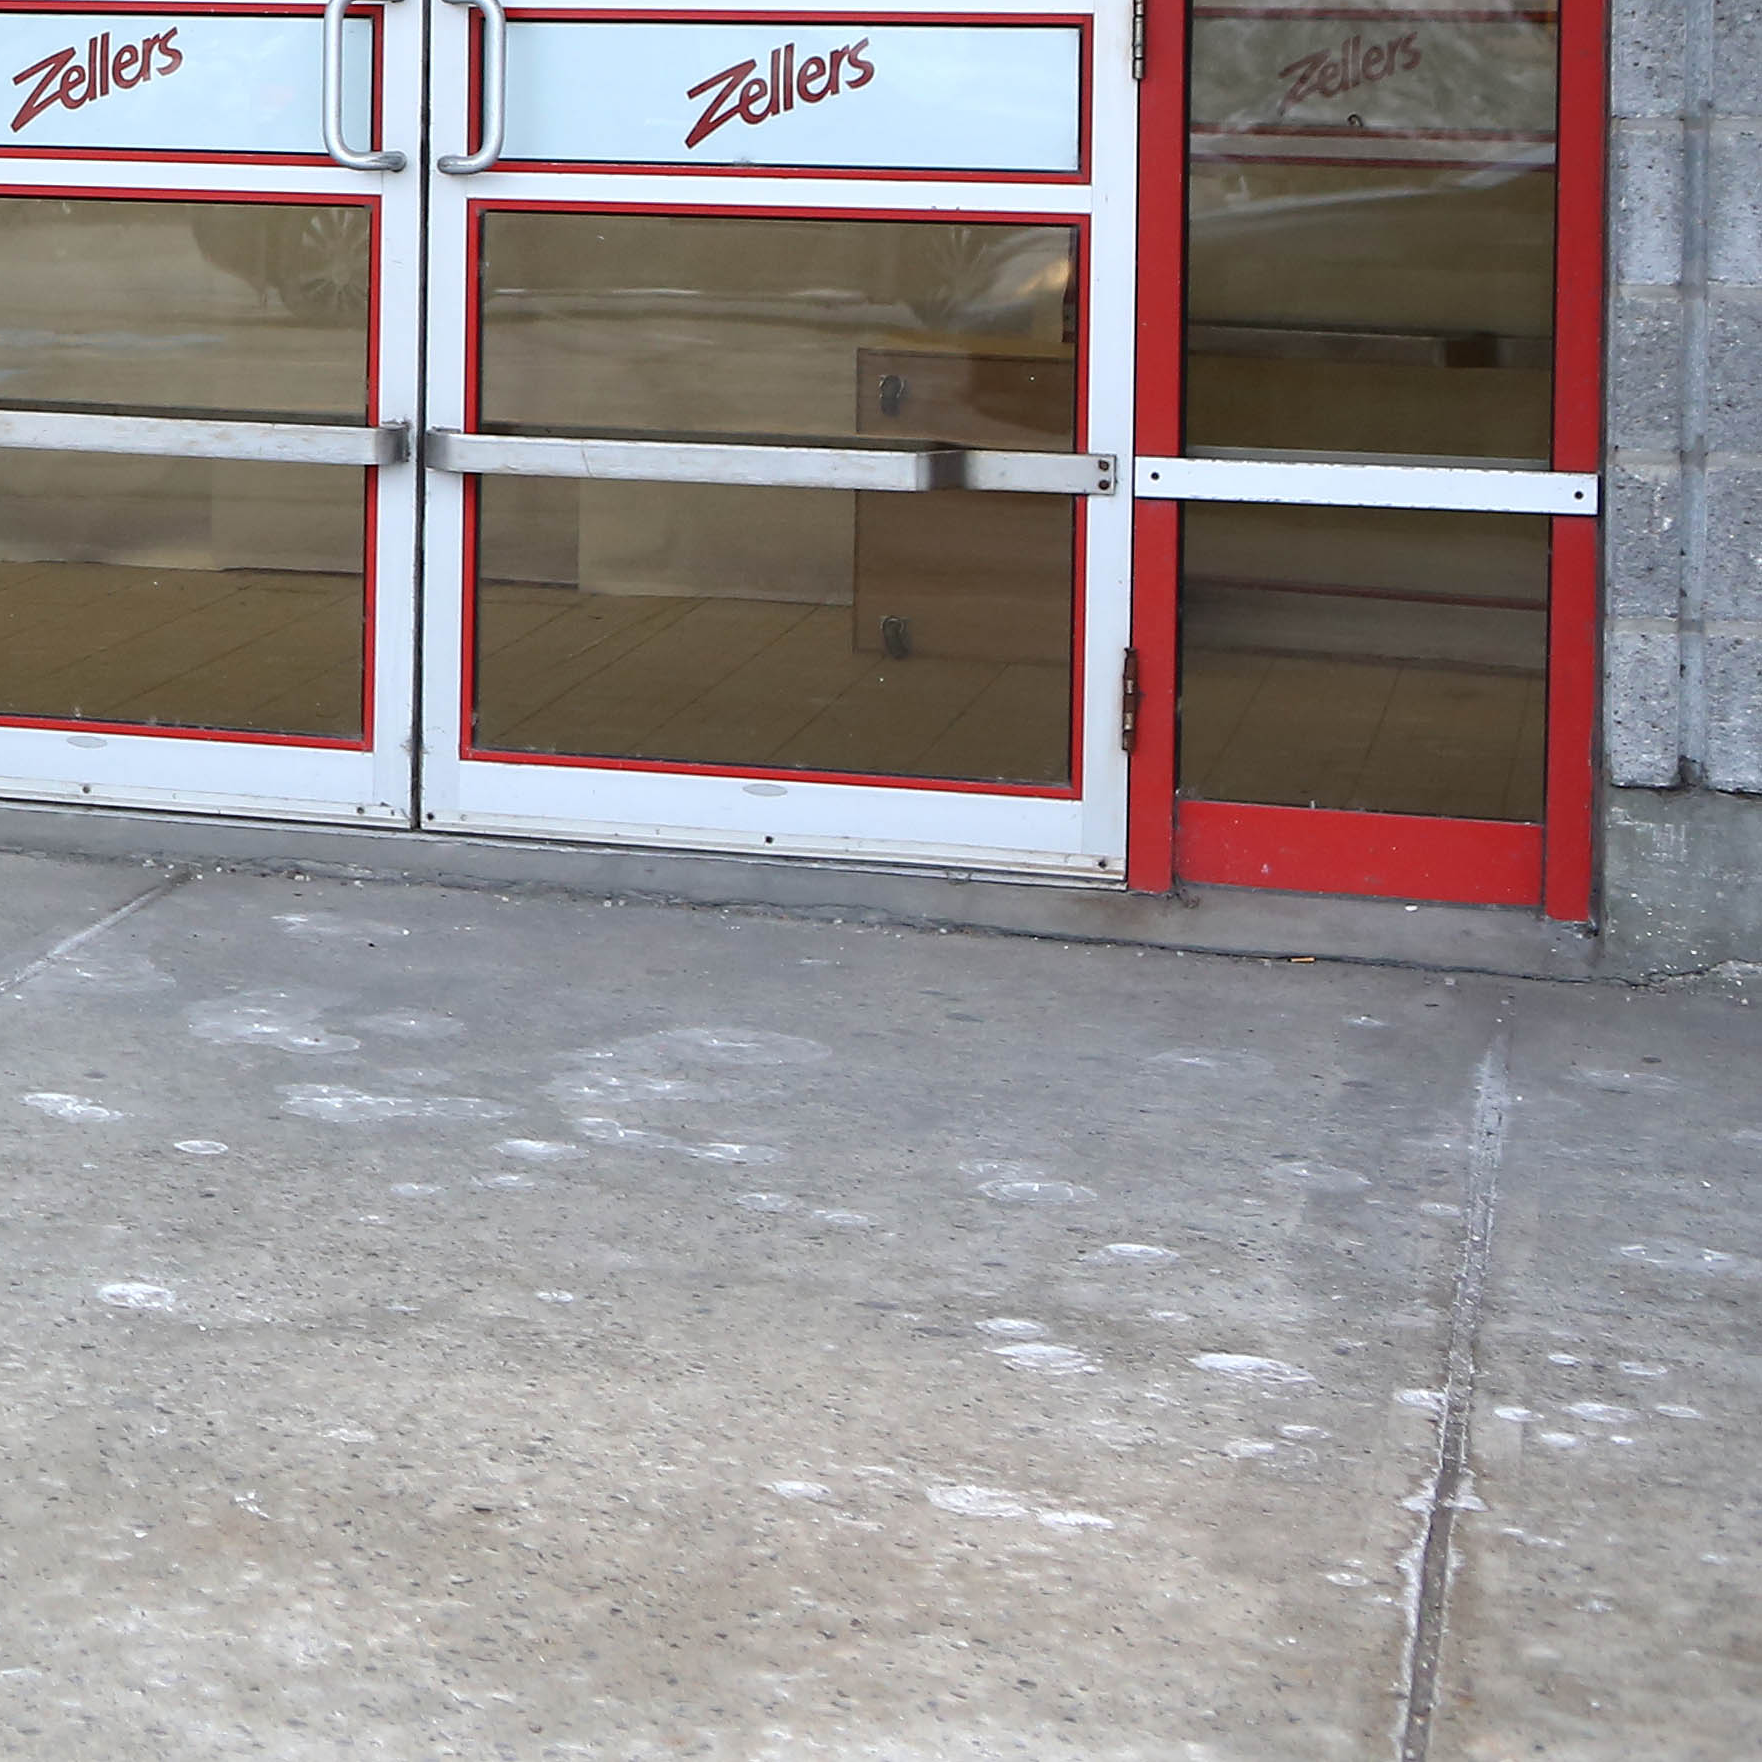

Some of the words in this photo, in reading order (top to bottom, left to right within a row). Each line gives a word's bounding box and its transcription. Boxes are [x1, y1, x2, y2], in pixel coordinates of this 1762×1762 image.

[10, 26, 183, 133] Zellers
[684, 38, 875, 149] Zellers
[1277, 31, 1423, 117] Zellers
